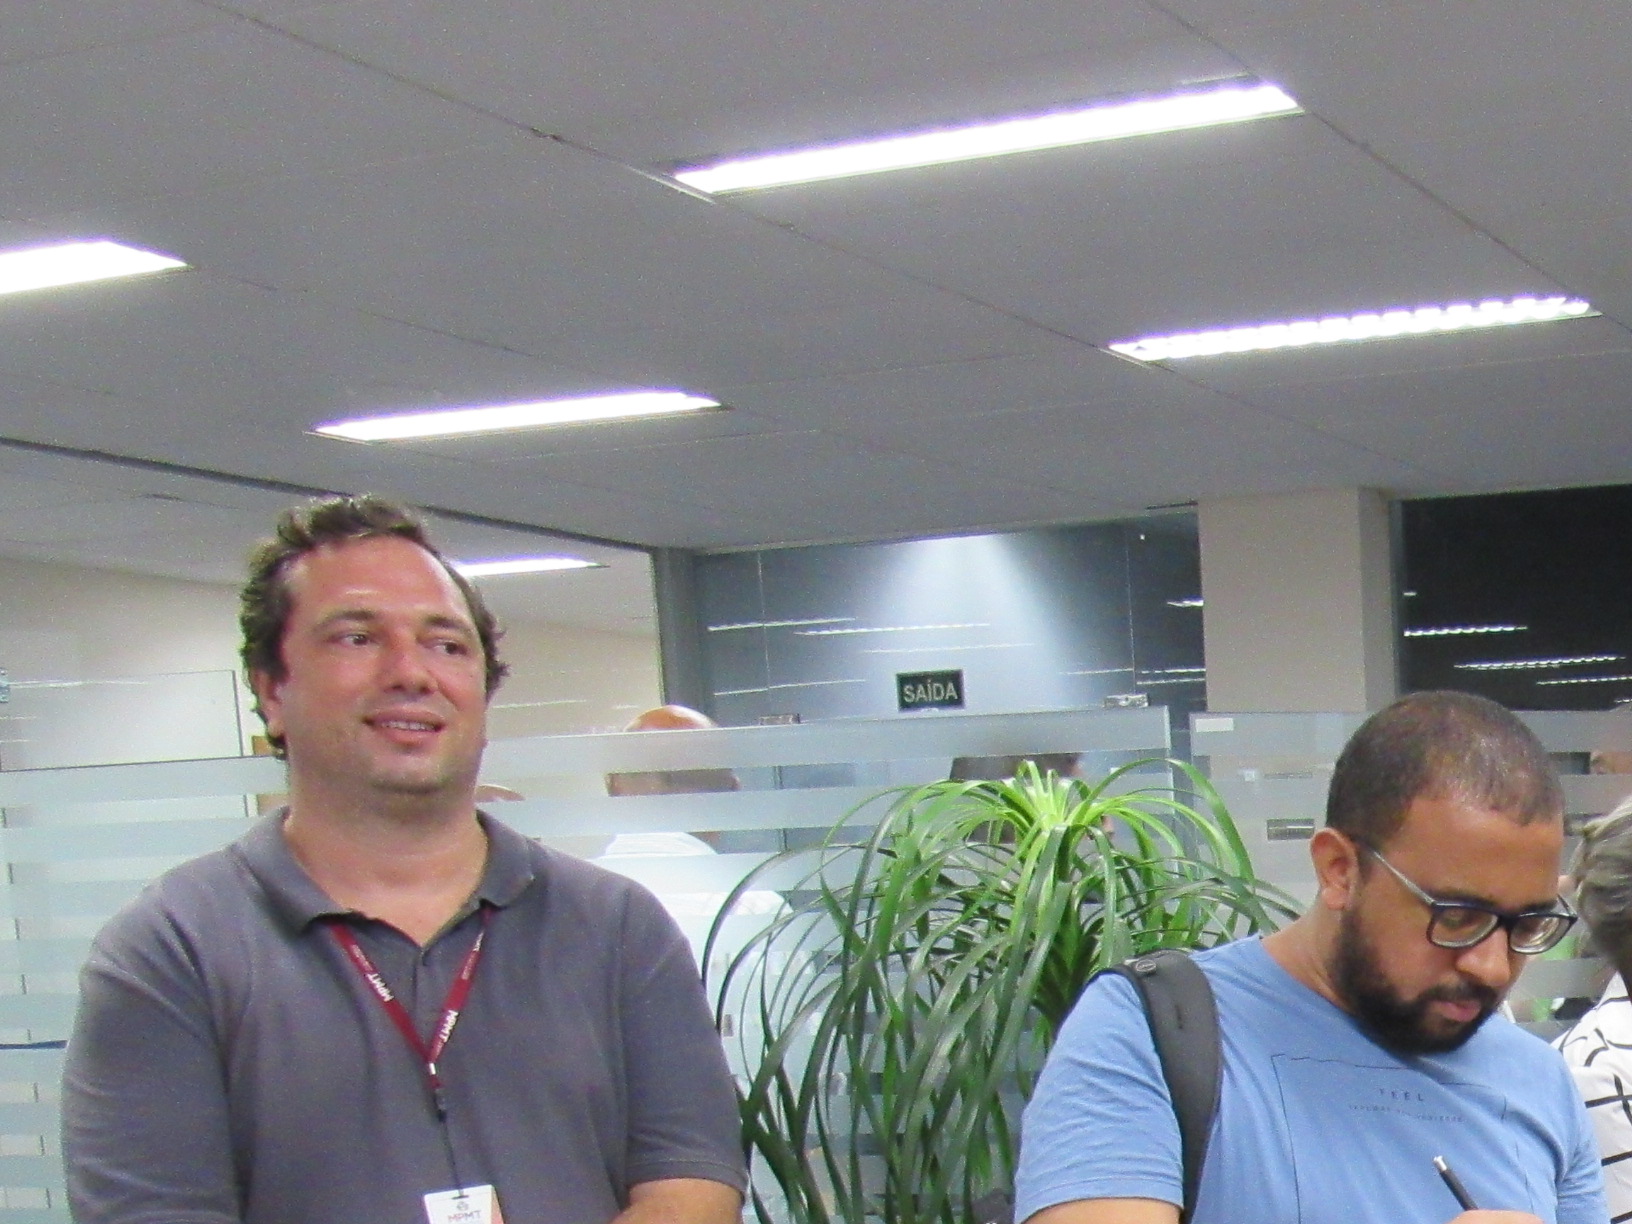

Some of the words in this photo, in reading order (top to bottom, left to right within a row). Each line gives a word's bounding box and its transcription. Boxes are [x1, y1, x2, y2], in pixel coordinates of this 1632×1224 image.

[903, 678, 959, 703] SAÍDA
[366, 973, 395, 1002] MPMT
[440, 1009, 459, 1043] MPMT
